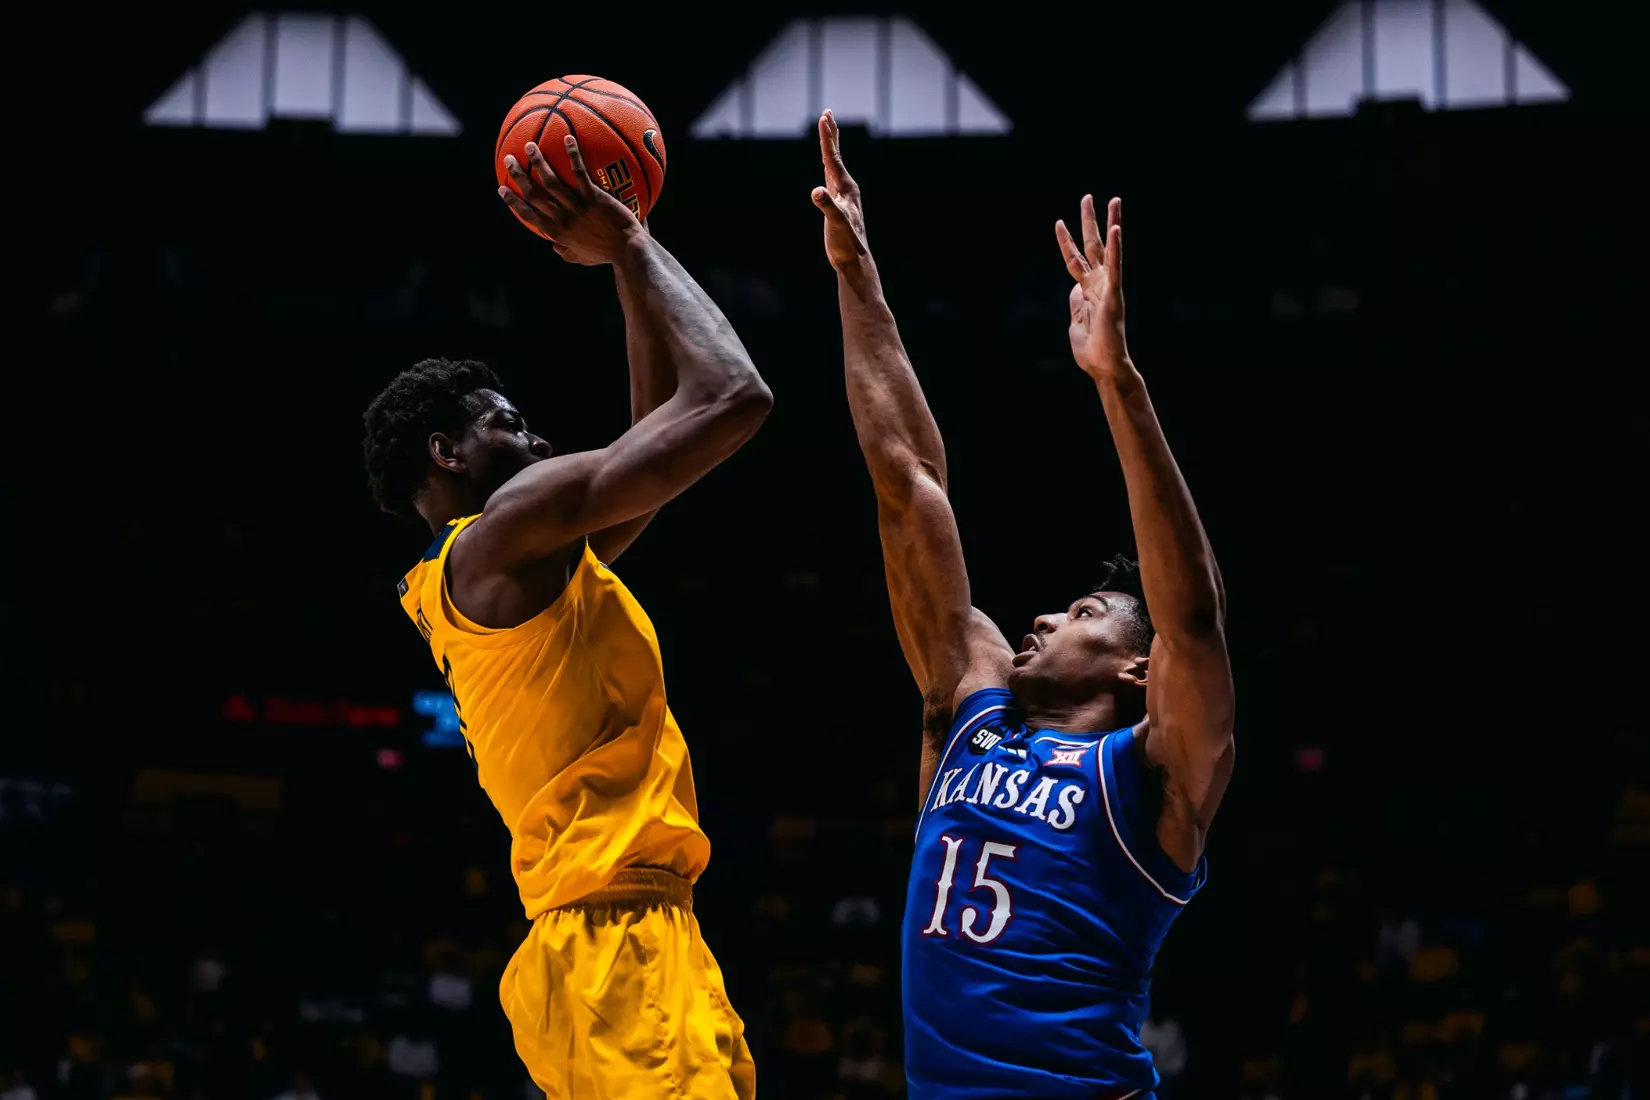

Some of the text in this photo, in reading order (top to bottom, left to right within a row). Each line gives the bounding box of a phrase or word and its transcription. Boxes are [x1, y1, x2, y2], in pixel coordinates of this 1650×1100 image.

[604, 156, 641, 220] ELI
[972, 728, 1003, 750] SW
[929, 761, 1087, 831] KANSAS
[921, 834, 1020, 945] 15
